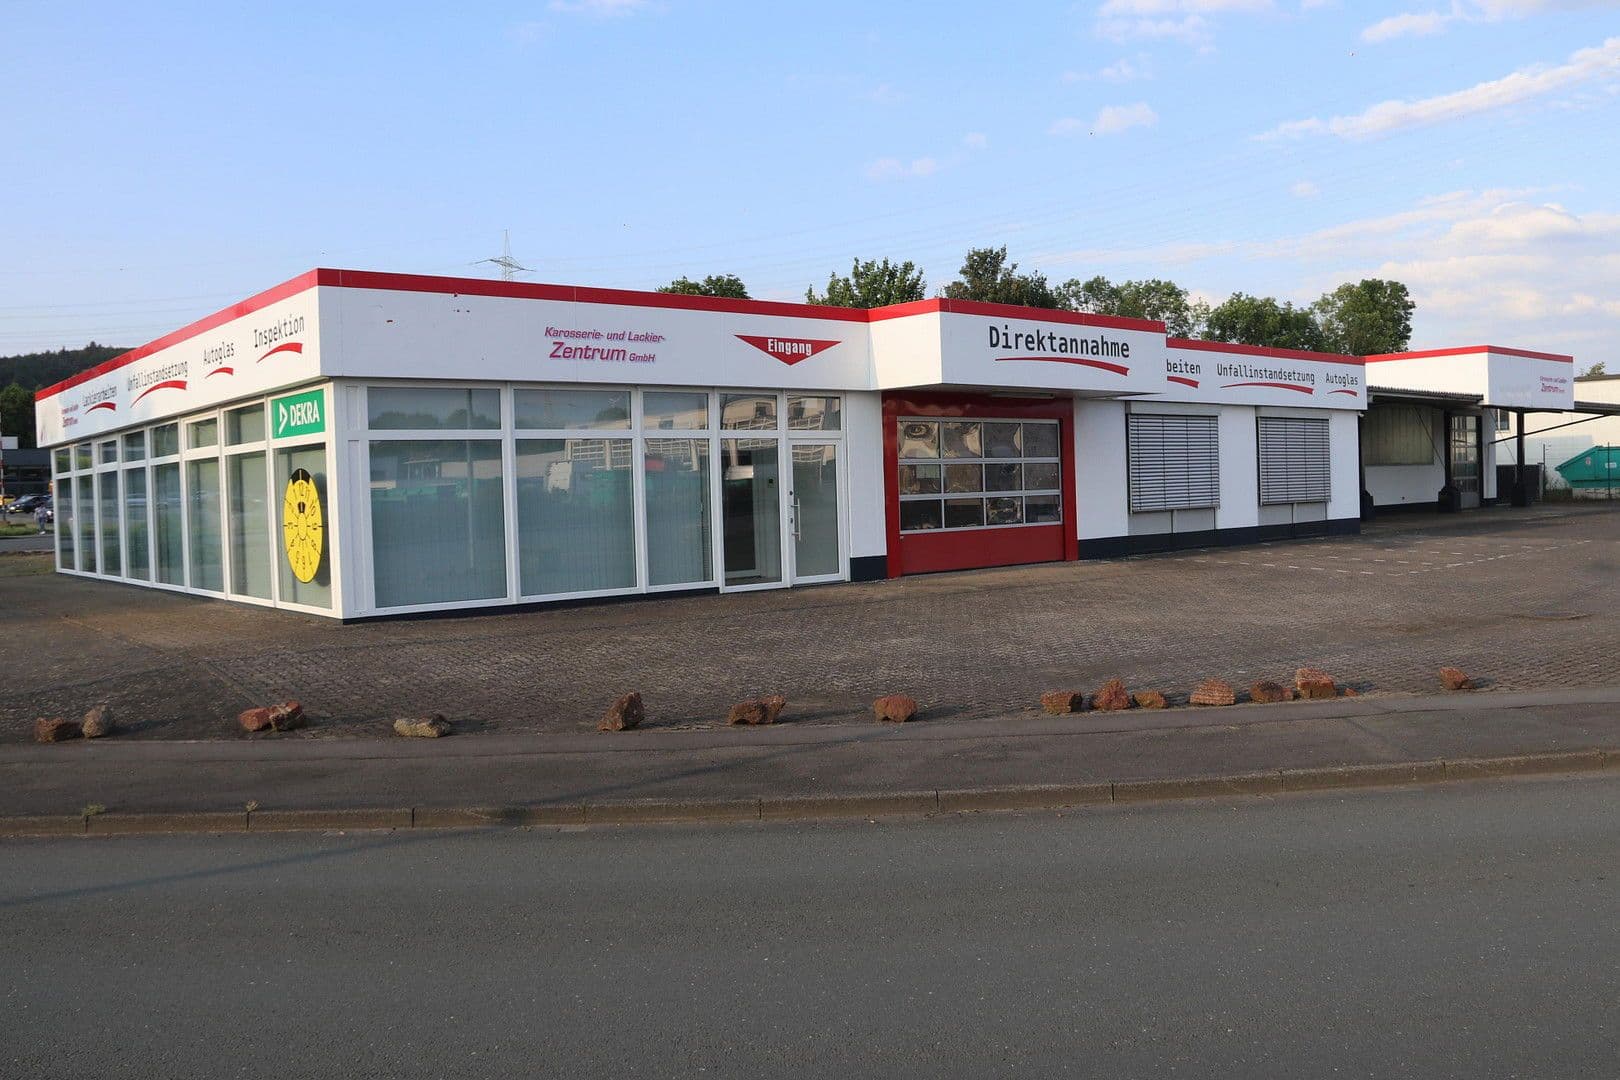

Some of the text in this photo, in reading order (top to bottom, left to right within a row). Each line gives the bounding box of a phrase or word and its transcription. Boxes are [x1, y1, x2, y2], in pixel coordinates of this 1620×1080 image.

[253, 313, 305, 348] Inspektion
[544, 326, 666, 343] Karosserie- und Lackier-
[203, 341, 235, 365] Autoglas
[549, 342, 656, 363] Zentrum GmbH
[768, 338, 811, 356] Eingang
[988, 325, 1130, 359] Direktannahme
[1217, 363, 1315, 385] Unfallinstandsetzung
[1325, 372, 1358, 387] Autoglas
[289, 399, 320, 427] DEKRA
